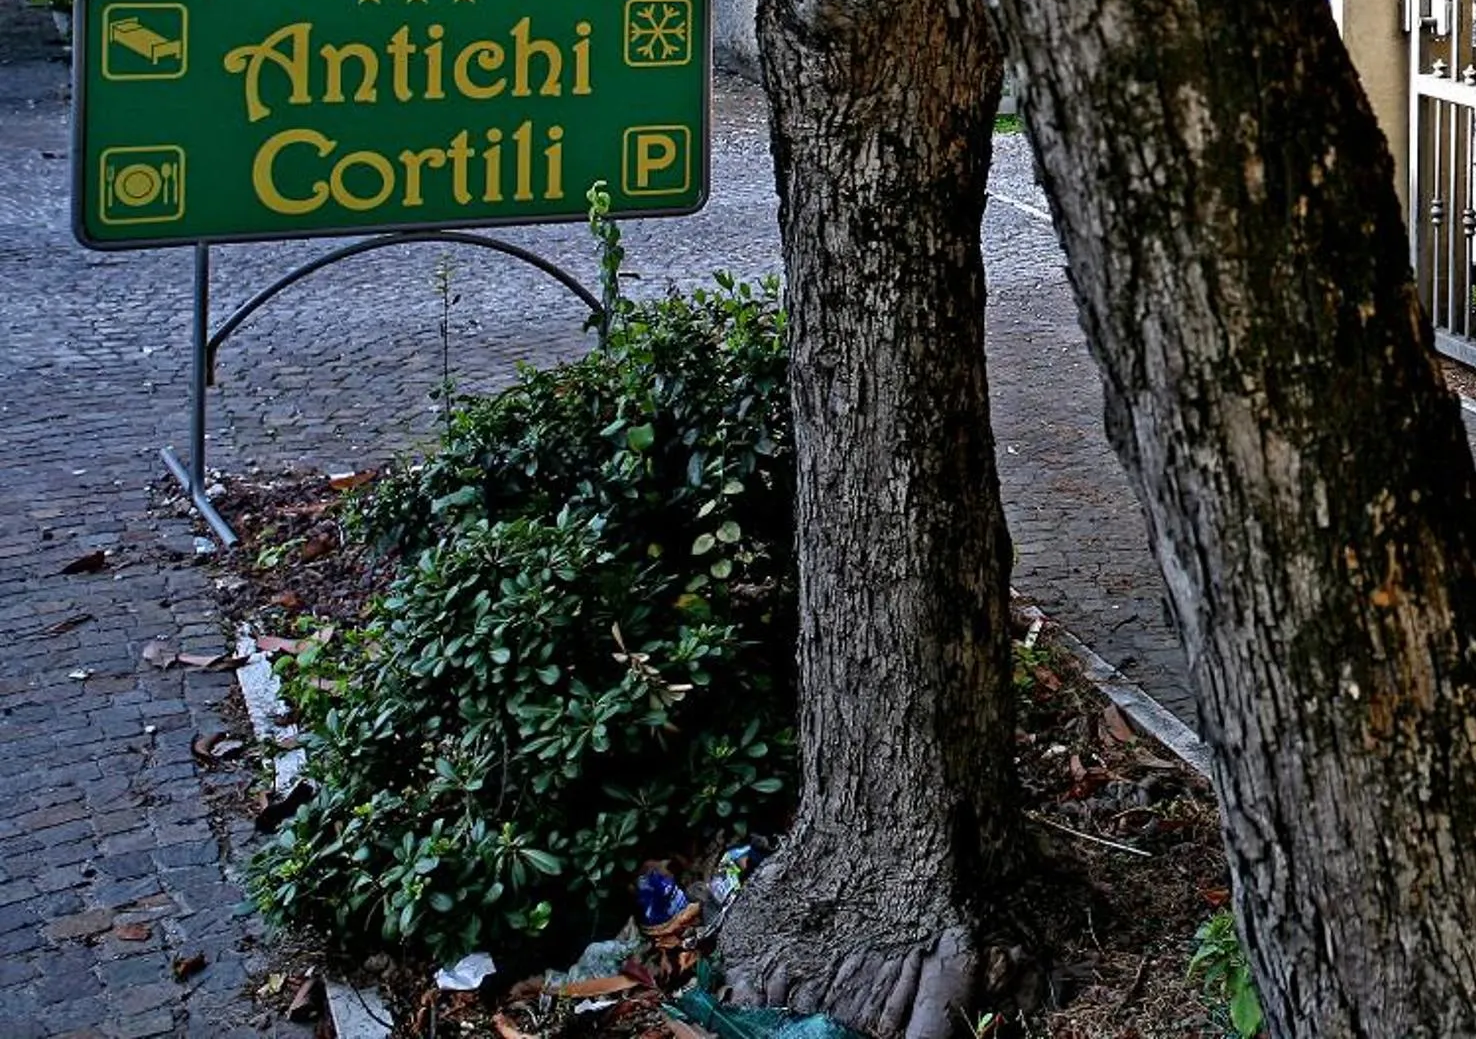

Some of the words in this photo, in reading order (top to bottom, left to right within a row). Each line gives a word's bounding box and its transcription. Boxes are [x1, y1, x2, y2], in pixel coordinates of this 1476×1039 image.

[223, 16, 593, 122] Antichi
[252, 120, 565, 216] Cortili
[636, 134, 678, 188] P
